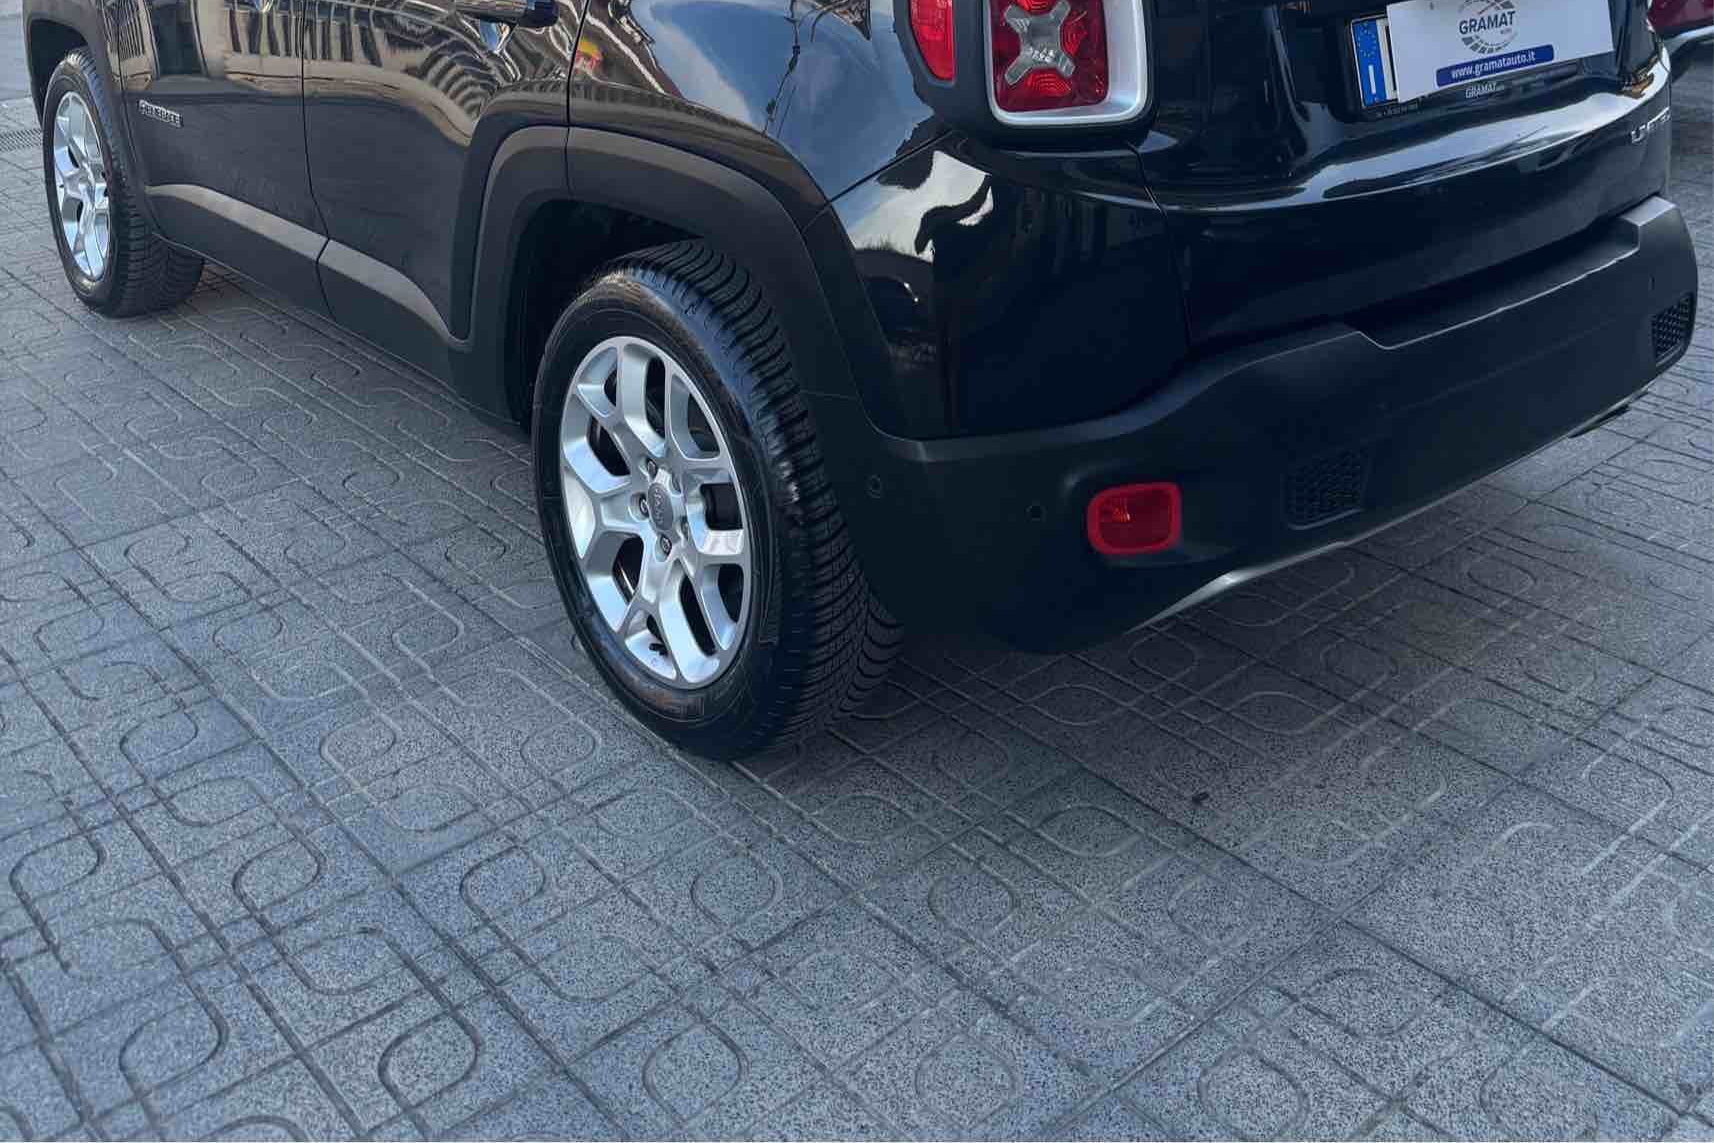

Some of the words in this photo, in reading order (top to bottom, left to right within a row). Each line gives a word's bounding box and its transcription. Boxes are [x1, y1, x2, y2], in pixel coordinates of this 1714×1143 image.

[1459, 10, 1516, 35] GRAMAT
[1450, 50, 1536, 79] www.gramatauto.it
[1465, 82, 1498, 99] GRAMAT
